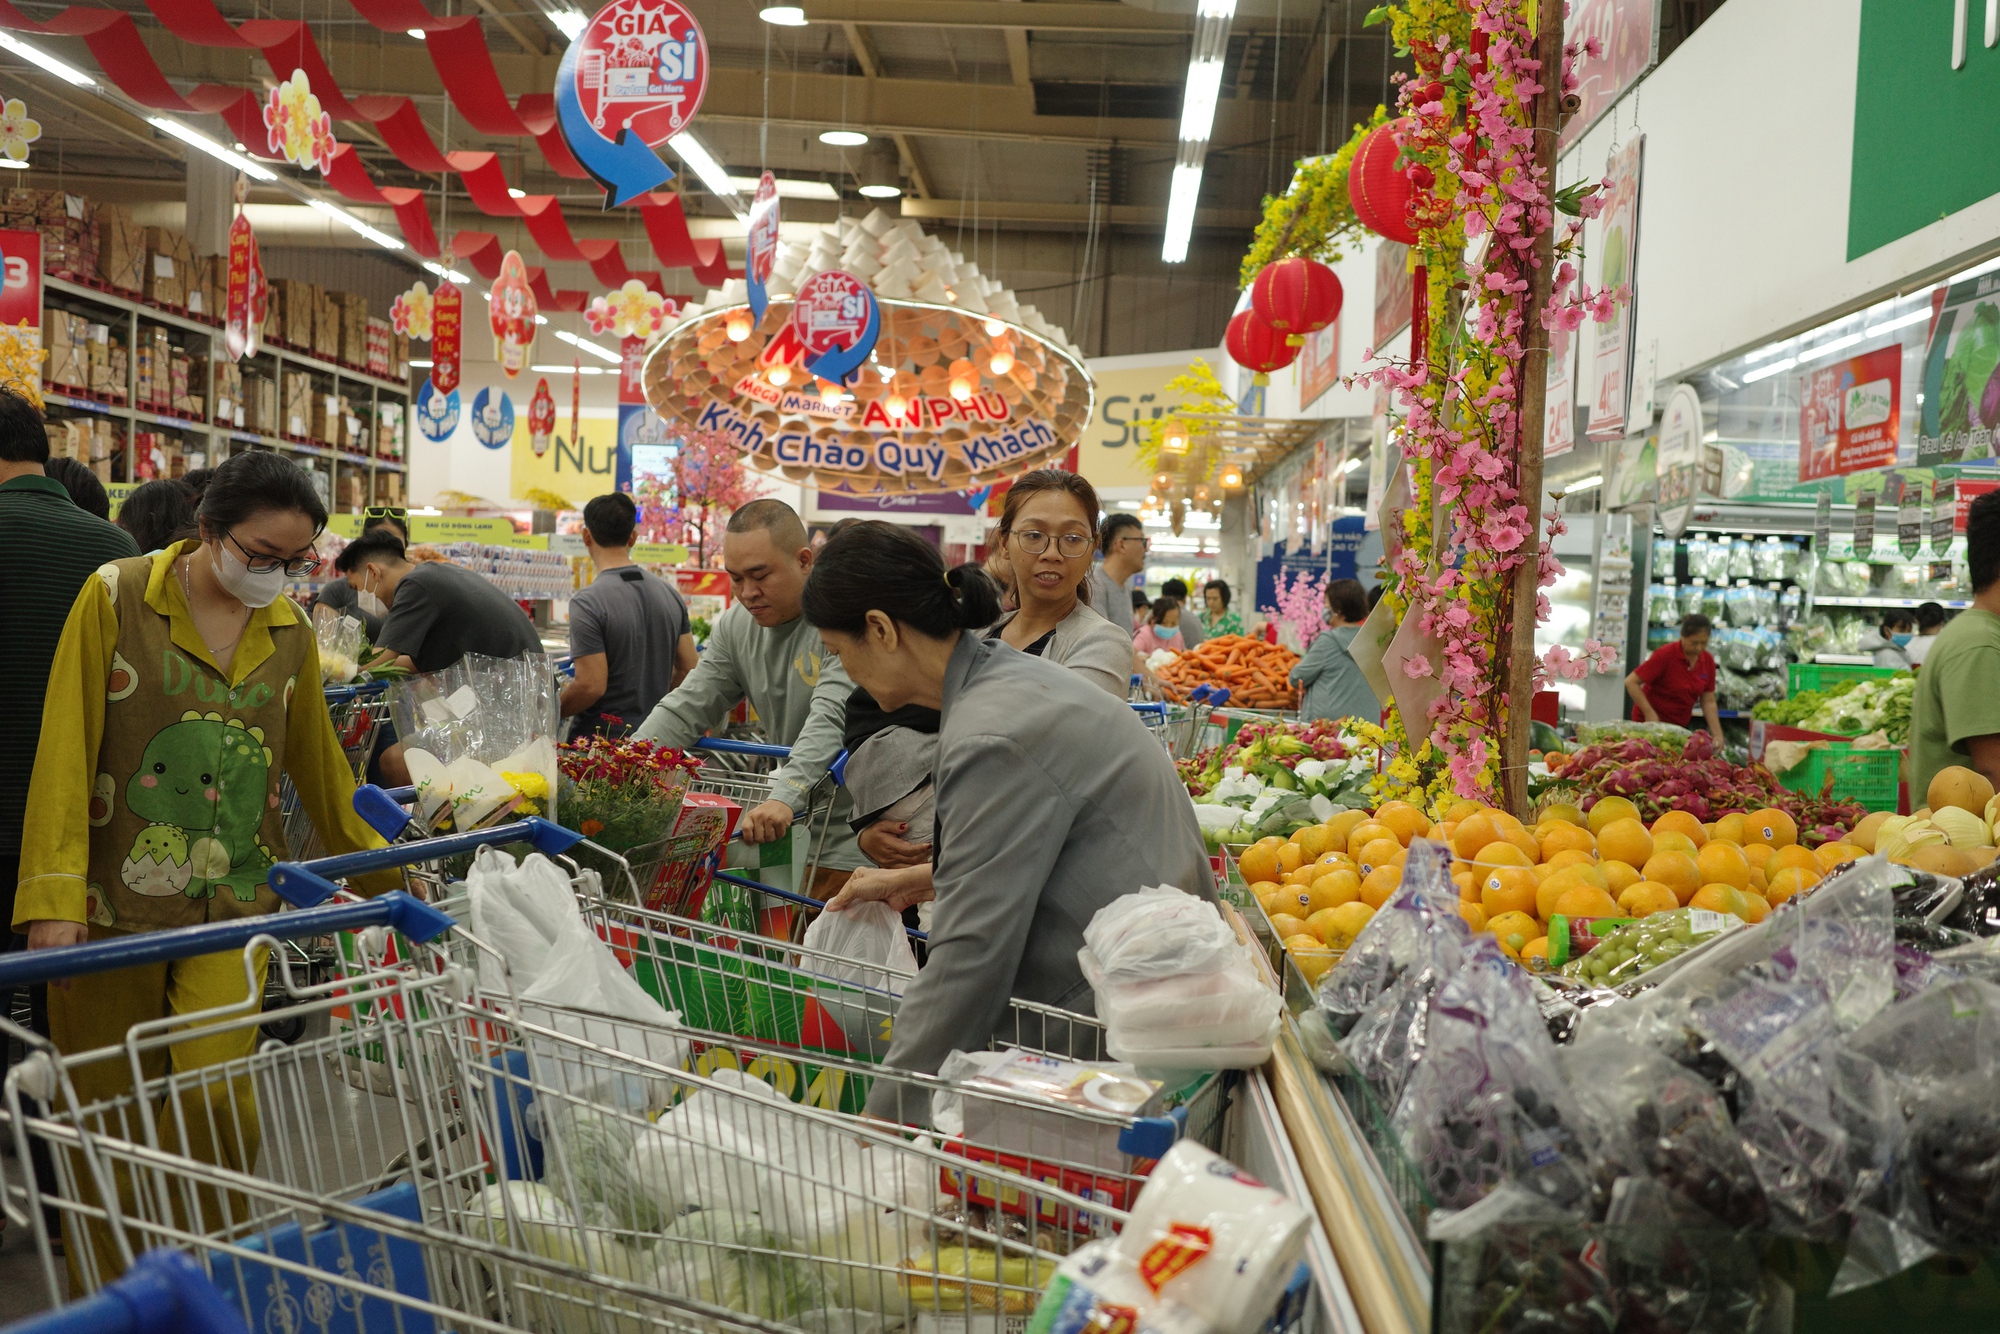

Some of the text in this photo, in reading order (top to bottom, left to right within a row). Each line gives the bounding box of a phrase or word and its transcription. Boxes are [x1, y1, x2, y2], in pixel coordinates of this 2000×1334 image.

[615, 7, 668, 36] GIÁ
[659, 30, 697, 82] SỈ
[777, 433, 865, 467] Chào
[879, 442, 944, 477] Quý
[962, 418, 1053, 470] Khách
